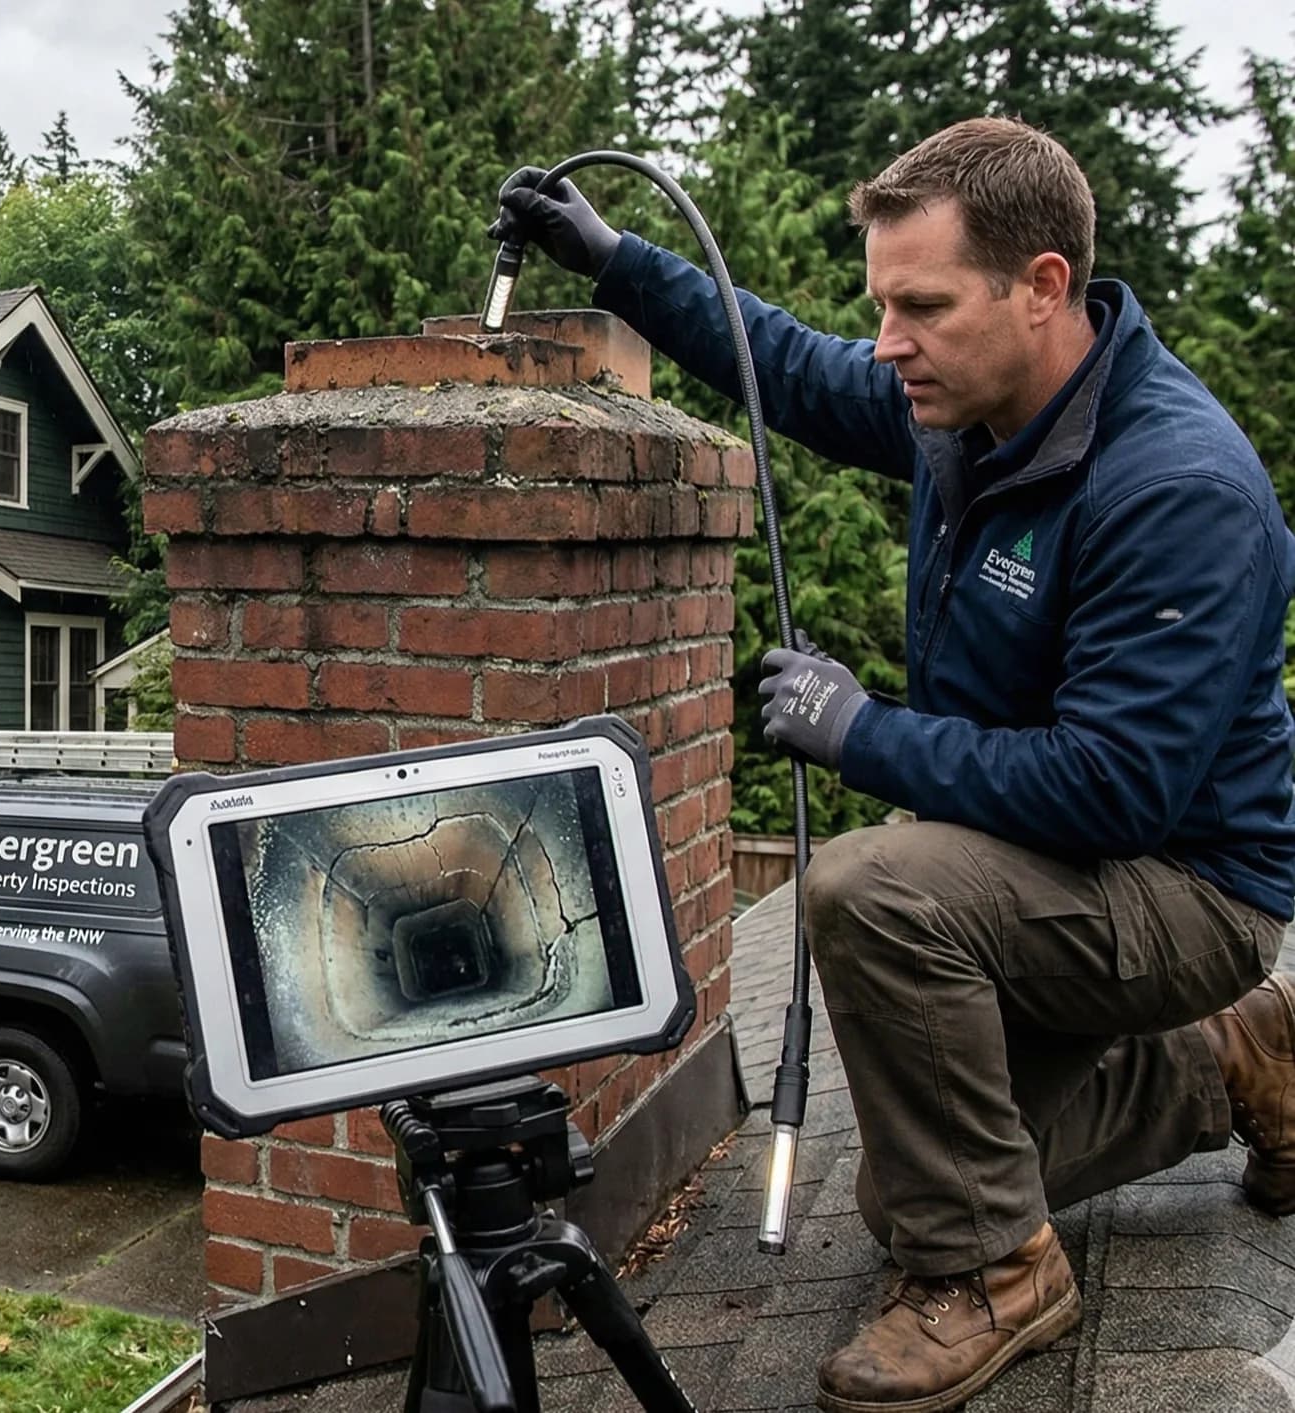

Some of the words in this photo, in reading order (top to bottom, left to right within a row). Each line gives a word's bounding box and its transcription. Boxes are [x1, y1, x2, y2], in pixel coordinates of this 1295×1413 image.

[32, 873, 136, 898] Inspections
[41, 927, 65, 943] the
[68, 928, 105, 945] PNW
